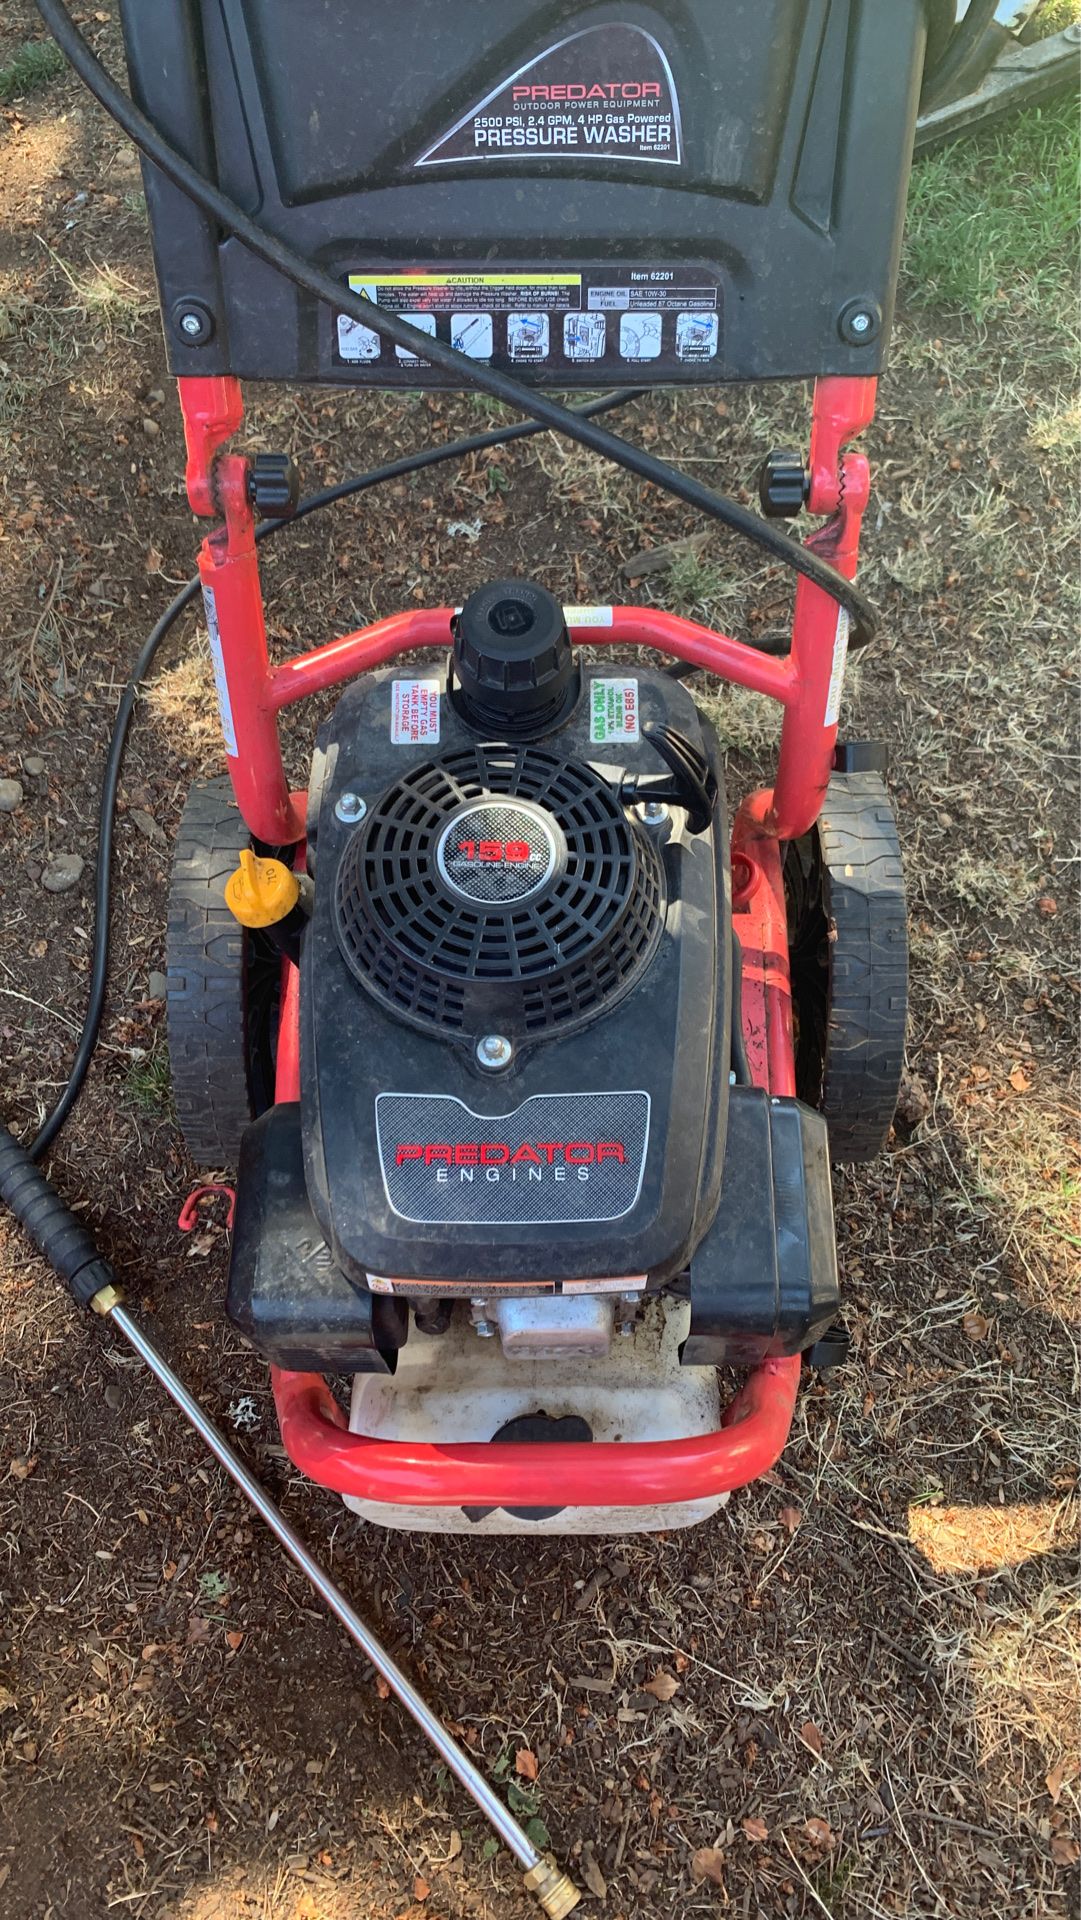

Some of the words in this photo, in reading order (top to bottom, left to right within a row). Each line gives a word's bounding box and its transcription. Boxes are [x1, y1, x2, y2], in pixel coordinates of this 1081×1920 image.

[513, 82, 661, 101] PREDATOR
[513, 102, 561, 111] OUTDOOR
[564, 101, 599, 109] POWER
[603, 99, 661, 108] EQUIPMENT
[474, 117, 503, 128] 2500
[505, 116, 525, 127] PSI,
[528, 115, 545, 126] 2.4
[547, 114, 575, 126] GPM,
[577, 114, 585, 125] 4
[587, 114, 603, 125] HP
[605, 113, 625, 124] Gas
[627, 112, 671, 123] Powered
[474, 127, 578, 147] PRESSURE
[583, 124, 671, 144] WASHER
[630, 272, 649, 281] Item
[650, 272, 674, 280] 62201
[411, 684, 419, 706] TANK
[420, 689, 428, 716] EMPTY
[429, 690, 437, 708] YOU
[594, 681, 605, 713] ONLY
[623, 688, 635, 711] E85)
[420, 719, 428, 736] GAS
[429, 710, 437, 733] MUST
[594, 715, 605, 740] GAS
[624, 714, 635, 733] (NO
[452, 860, 501, 868] GASOLINE
[504, 862, 541, 870] ENGINE
[395, 1142, 626, 1166] PREDATOR
[437, 1167, 590, 1182] ENGINES
